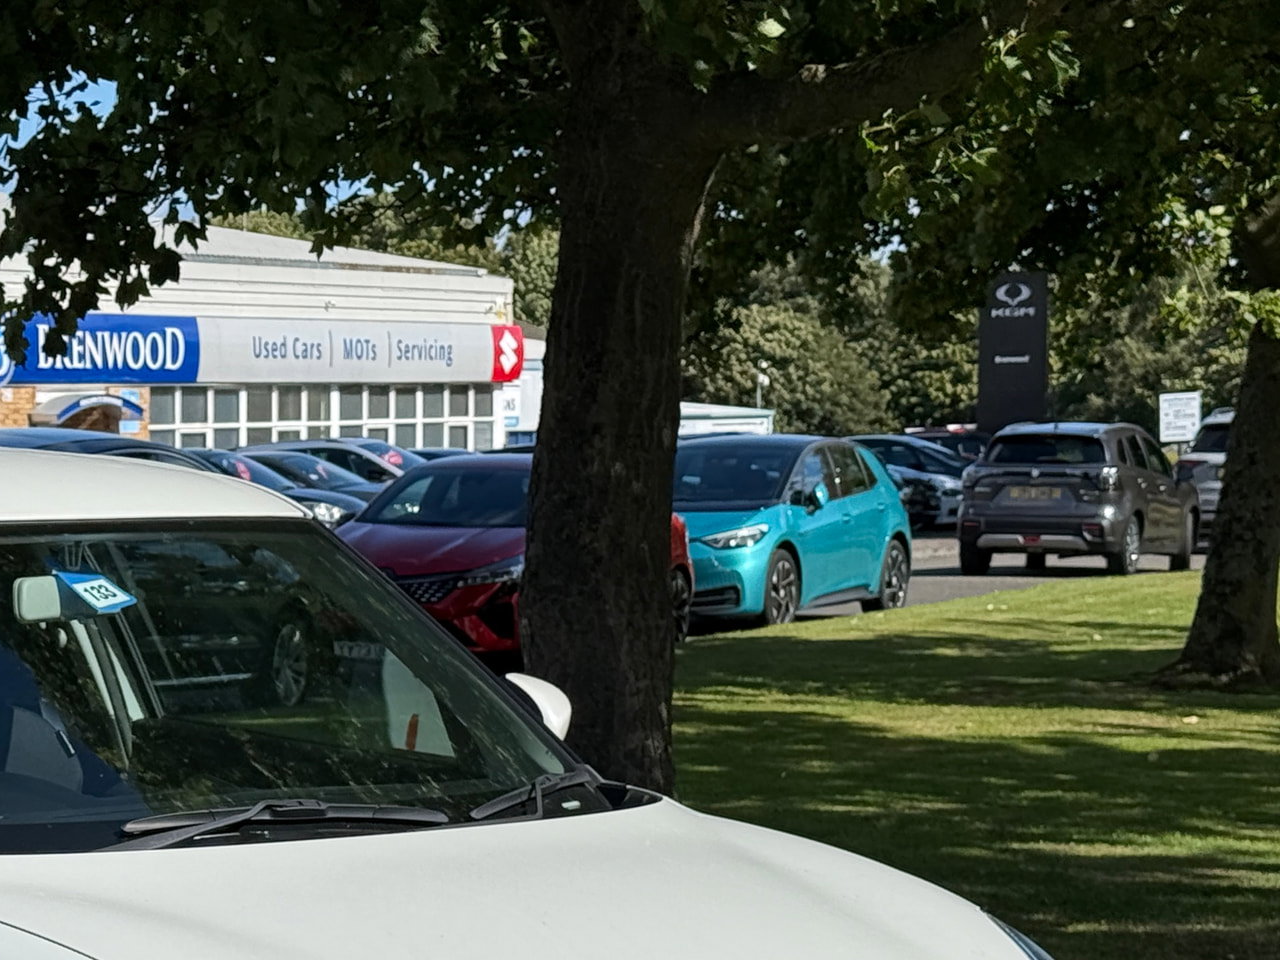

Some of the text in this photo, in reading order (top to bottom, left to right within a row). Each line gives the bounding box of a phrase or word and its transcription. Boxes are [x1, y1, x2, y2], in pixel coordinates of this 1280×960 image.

[252, 335, 322, 359] Used Cars
[343, 338, 377, 361] MOTs
[396, 339, 454, 367] Servicing
[83, 585, 118, 601] 133
